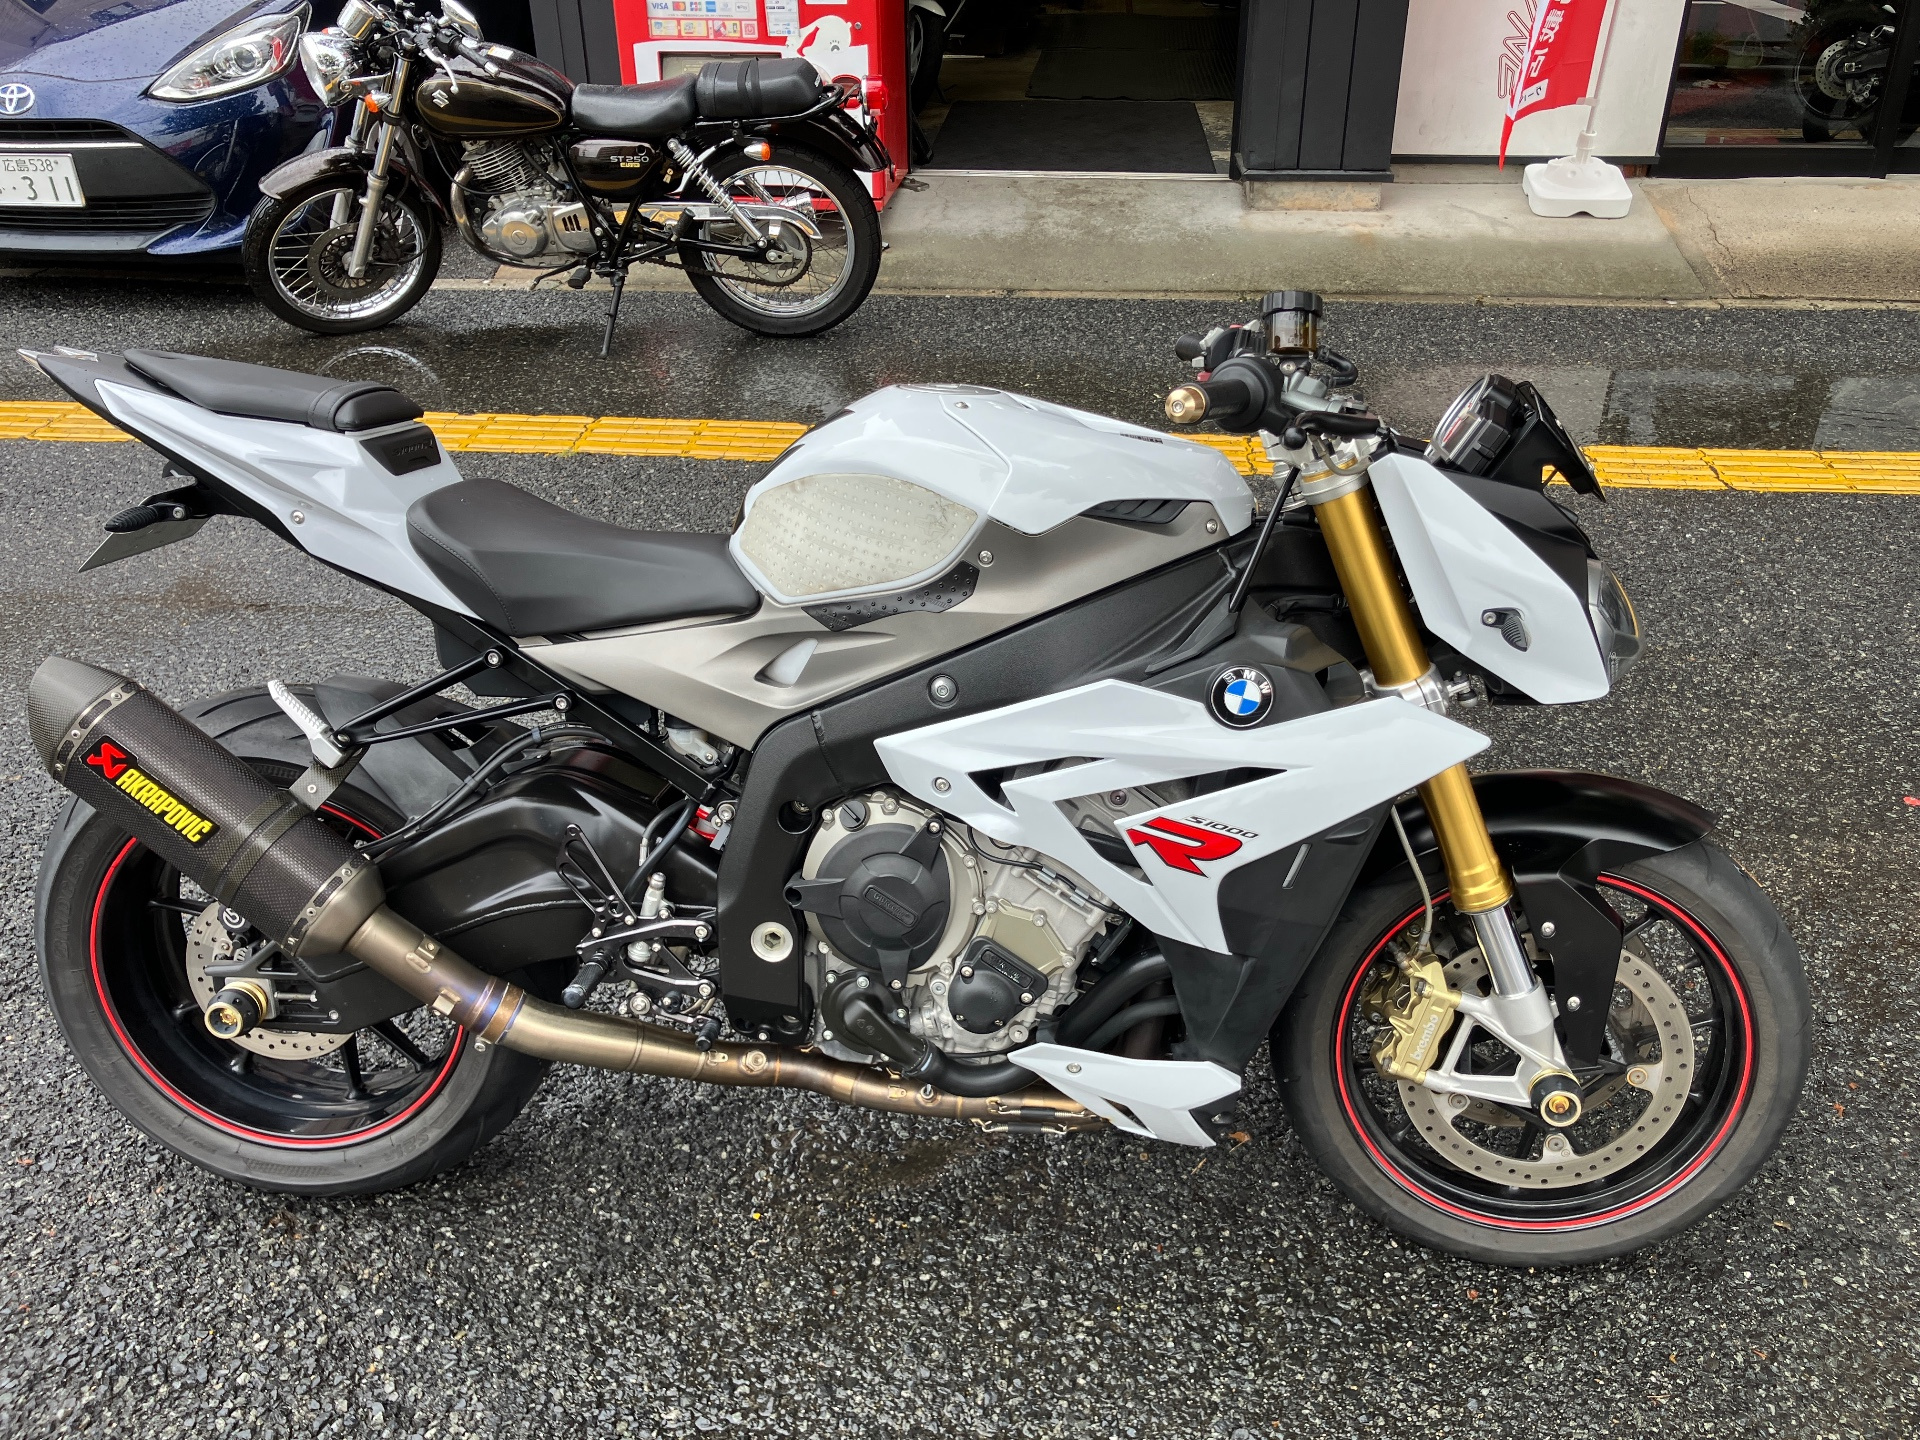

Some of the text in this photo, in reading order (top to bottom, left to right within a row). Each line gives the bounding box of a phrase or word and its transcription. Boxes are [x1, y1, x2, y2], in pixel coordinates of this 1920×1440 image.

[1222, 669, 1271, 694] BMW
[1186, 816, 1259, 839] S1000
[1125, 816, 1243, 879] R
[1410, 1014, 1439, 1061] brembo
